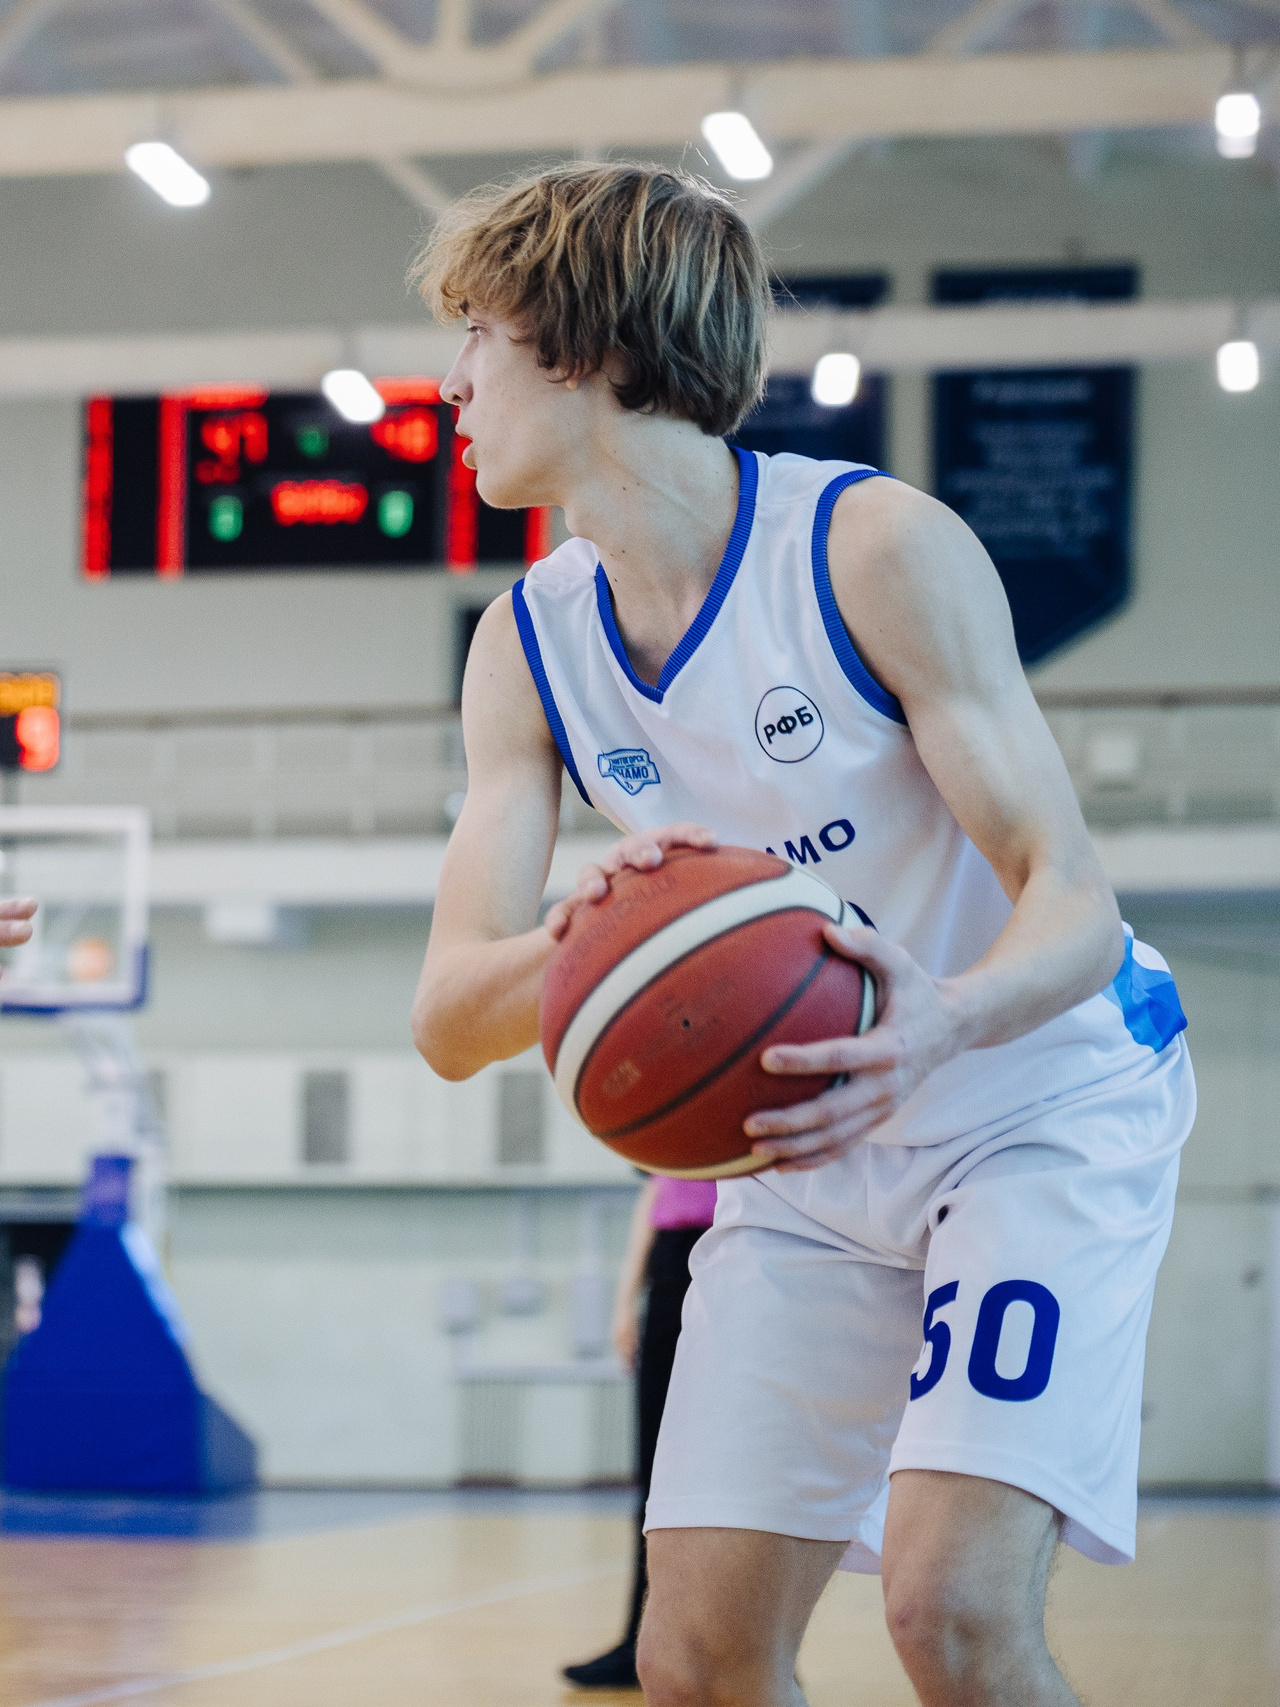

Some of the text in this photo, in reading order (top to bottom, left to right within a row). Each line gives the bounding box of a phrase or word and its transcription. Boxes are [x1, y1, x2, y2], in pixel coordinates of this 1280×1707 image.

[763, 705, 814, 745] РФБ
[765, 818, 856, 866] МО
[910, 1279, 1061, 1402] 50
